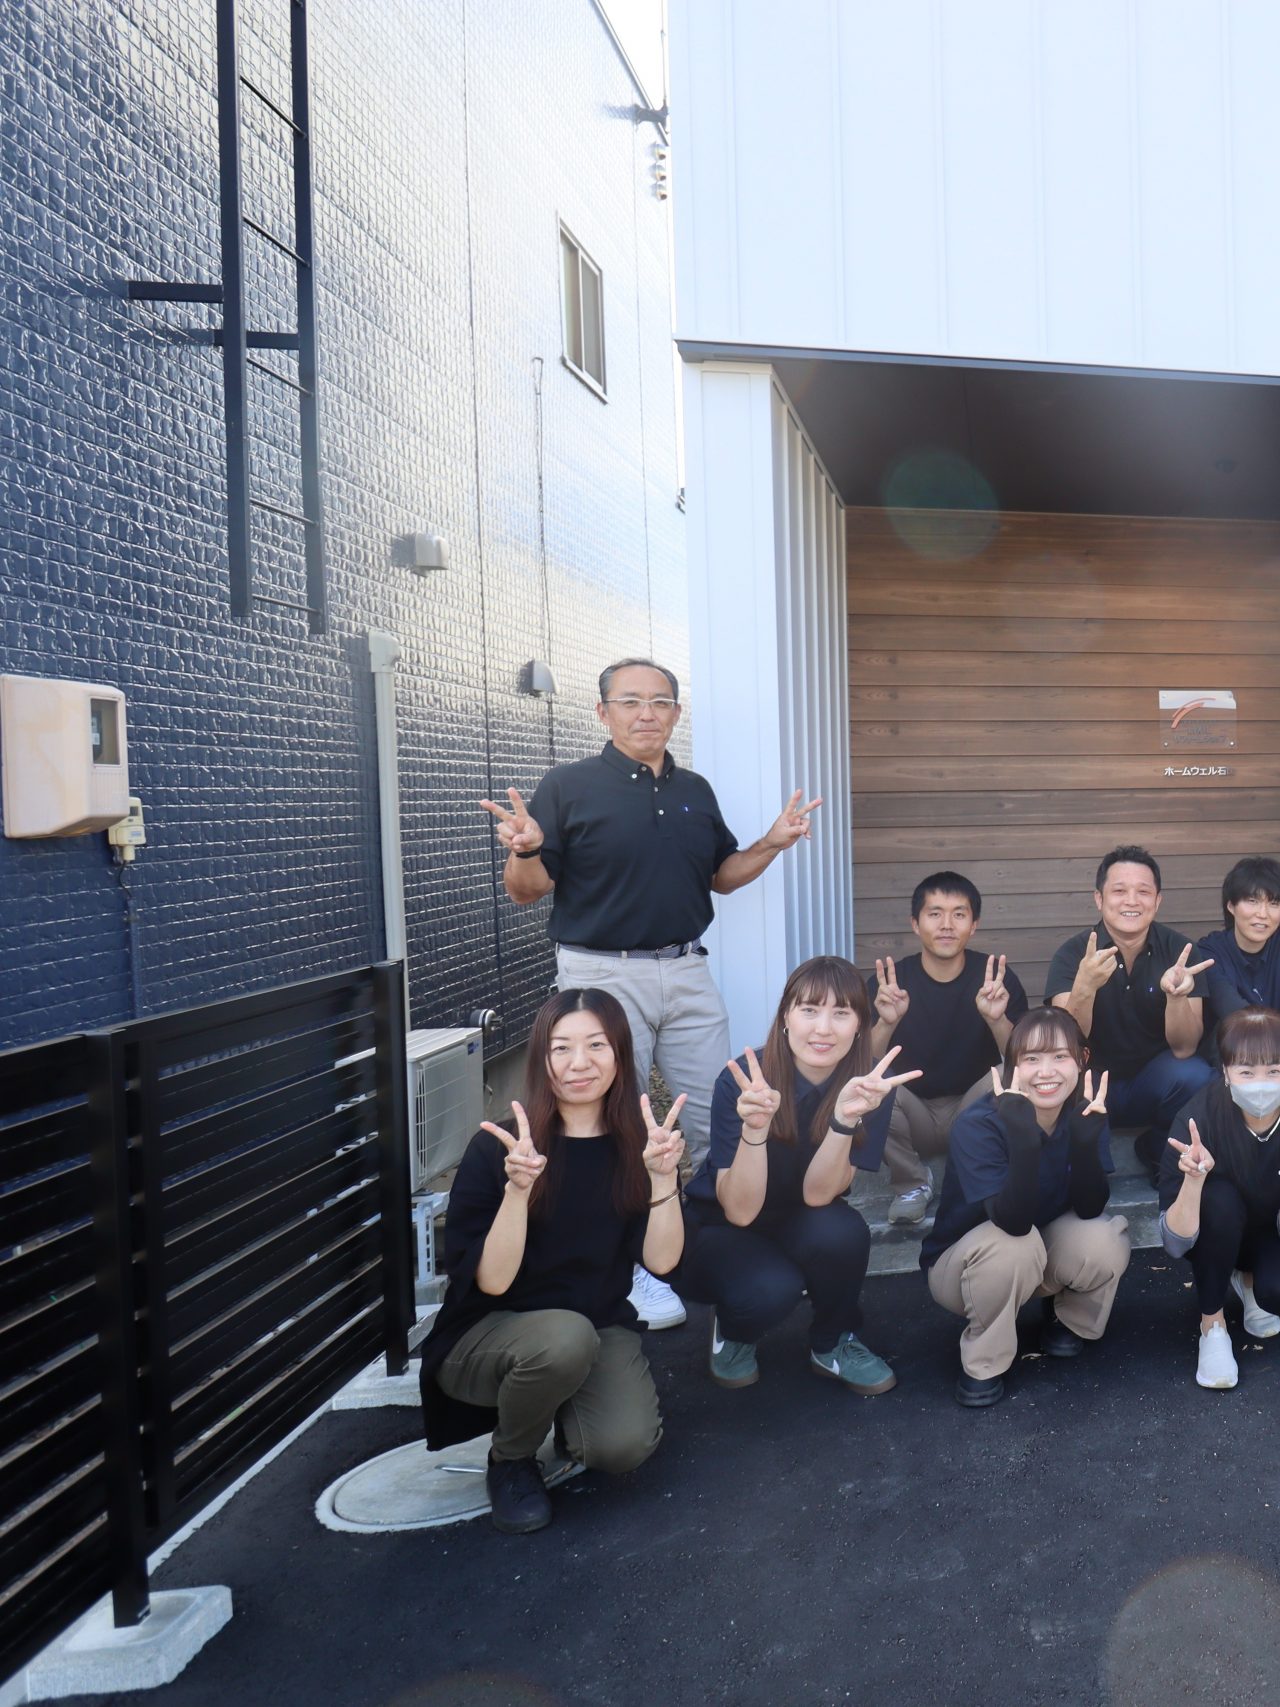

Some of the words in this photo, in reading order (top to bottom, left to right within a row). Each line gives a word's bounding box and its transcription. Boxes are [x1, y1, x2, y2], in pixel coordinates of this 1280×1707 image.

[1164, 766, 1234, 776] ホームウェル石
